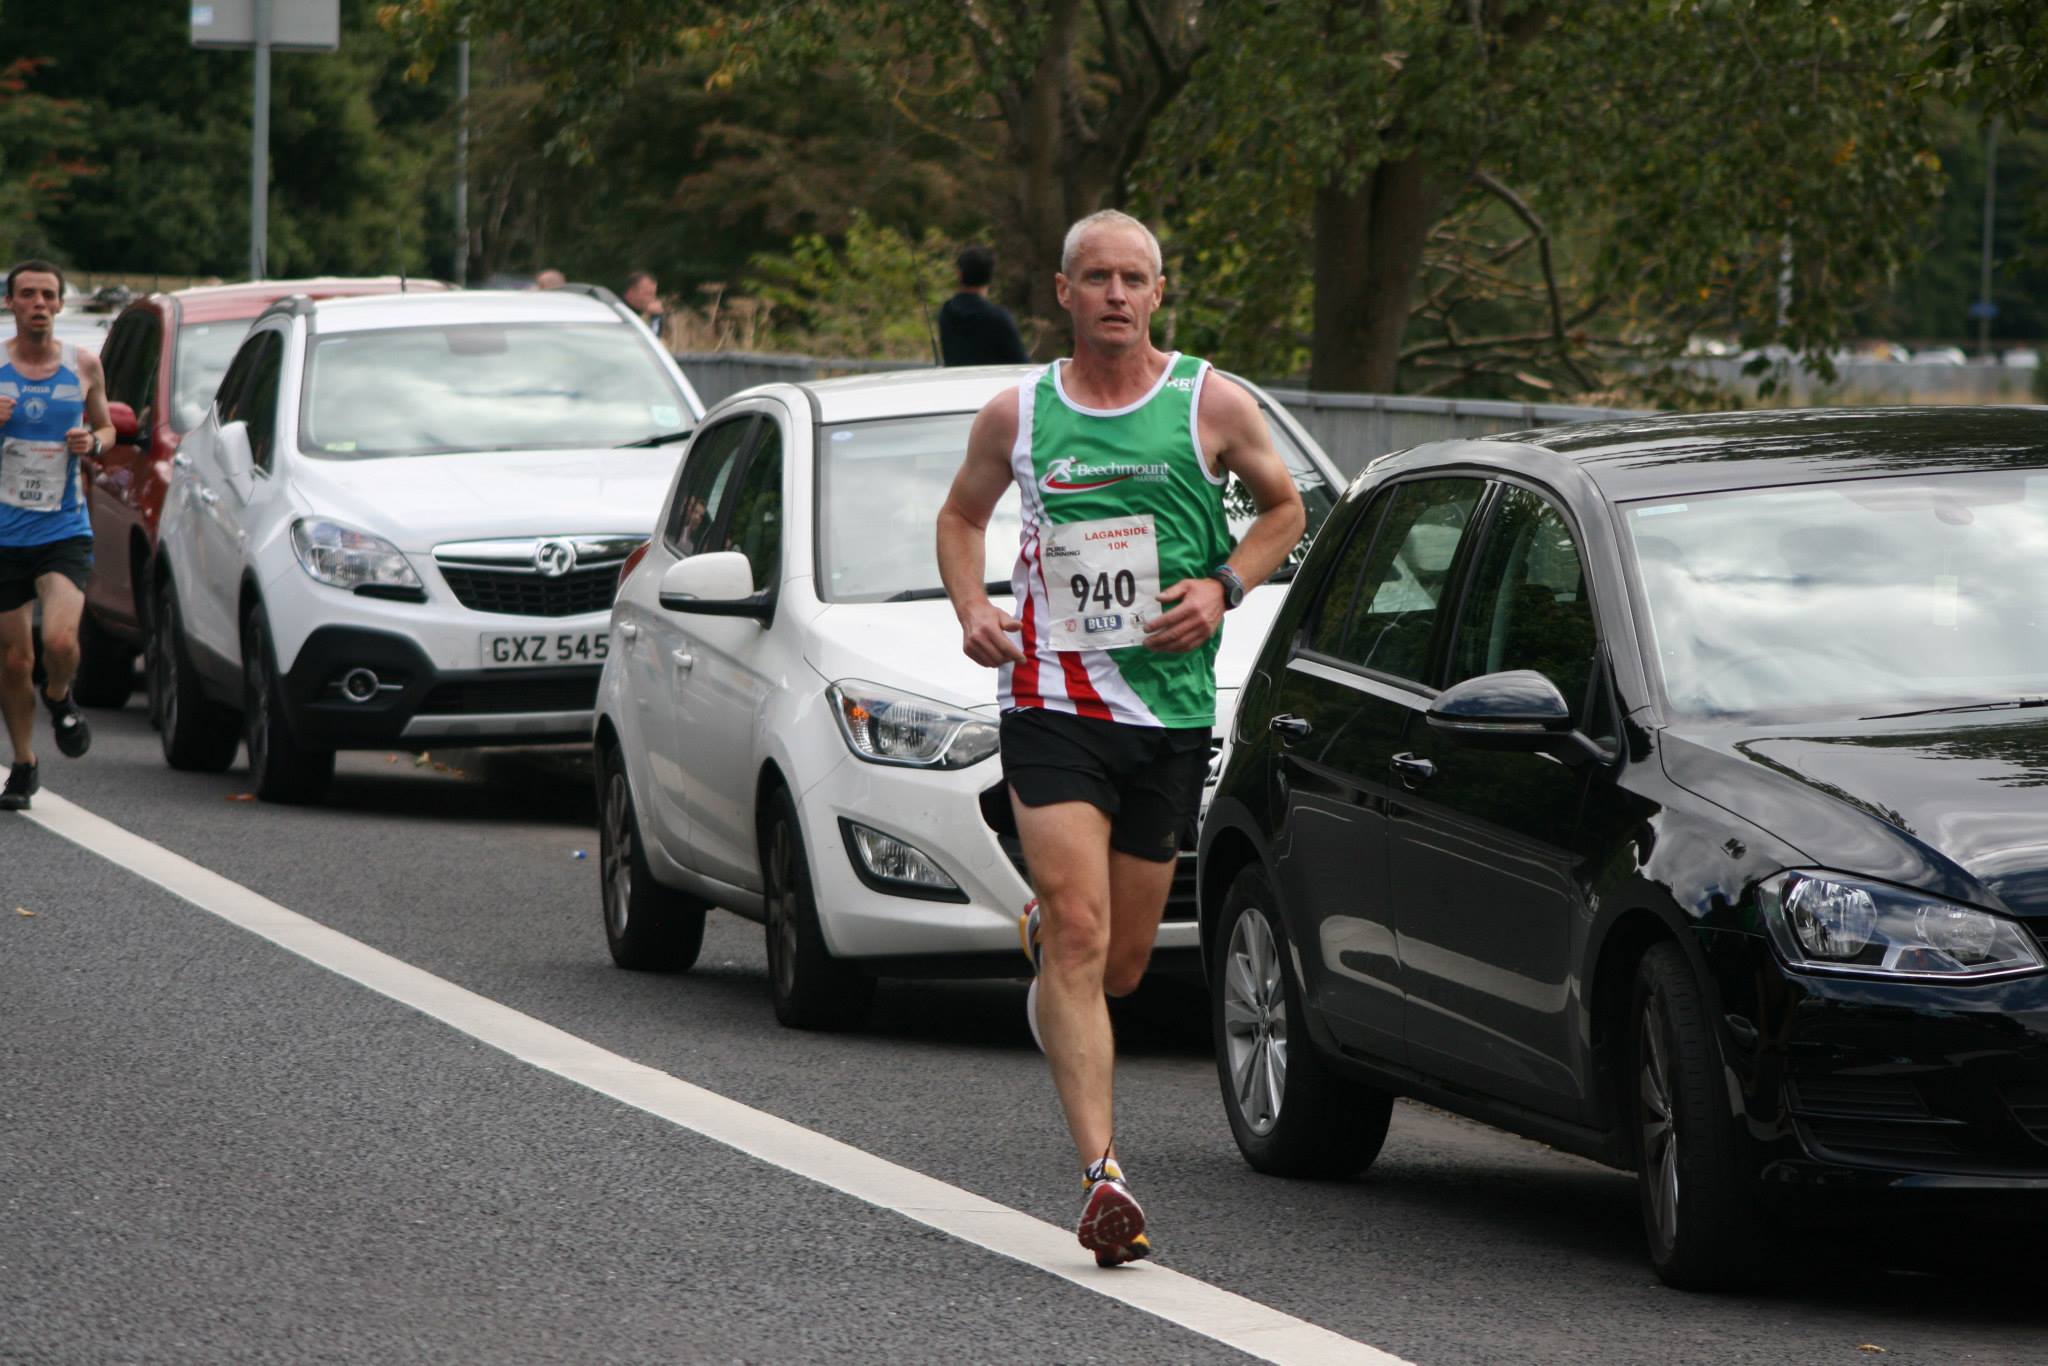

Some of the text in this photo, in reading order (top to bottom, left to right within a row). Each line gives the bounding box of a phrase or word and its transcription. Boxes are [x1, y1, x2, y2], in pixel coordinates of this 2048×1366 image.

[1077, 462, 1169, 477] Beechmount
[1085, 526, 1149, 541] LAGANSIDE
[1108, 541, 1129, 551] 10K
[1070, 569, 1136, 612] 940
[493, 636, 547, 662] GXZ
